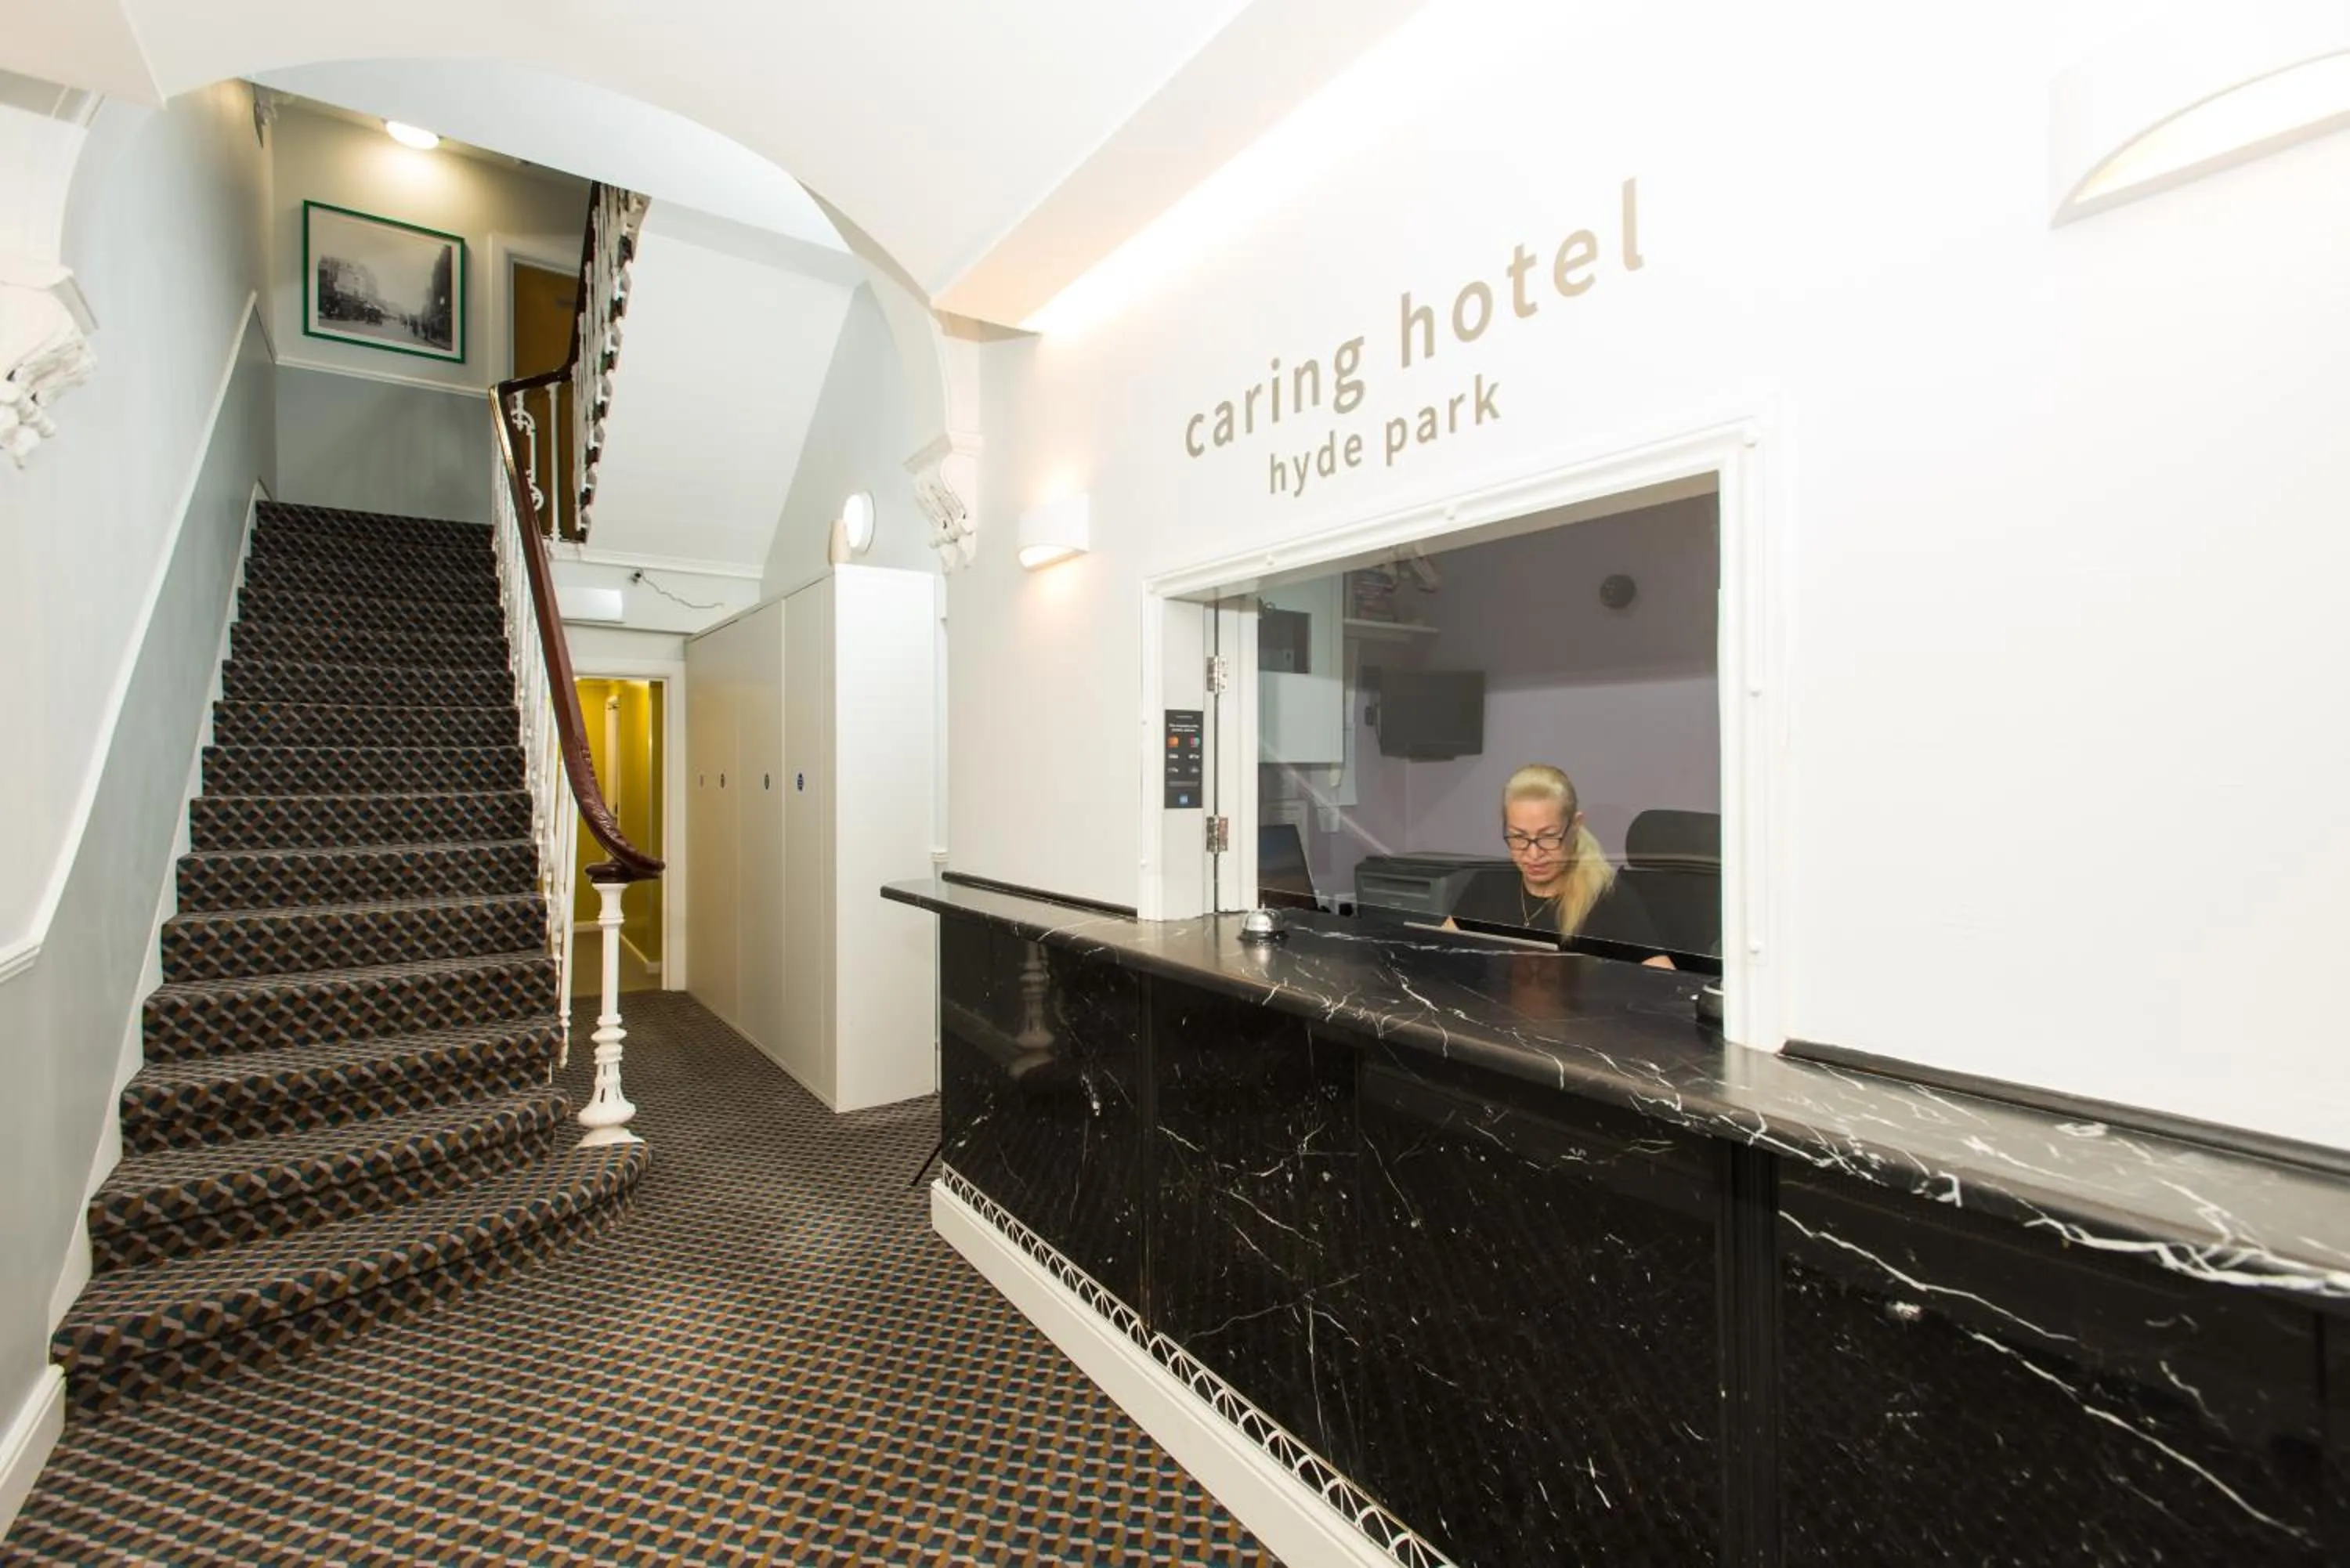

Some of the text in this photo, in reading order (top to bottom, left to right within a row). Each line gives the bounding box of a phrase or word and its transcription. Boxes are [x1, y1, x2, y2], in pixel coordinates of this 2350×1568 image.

[1184, 176, 1644, 460] caring hotel
[1269, 373, 1500, 499] hyde park
